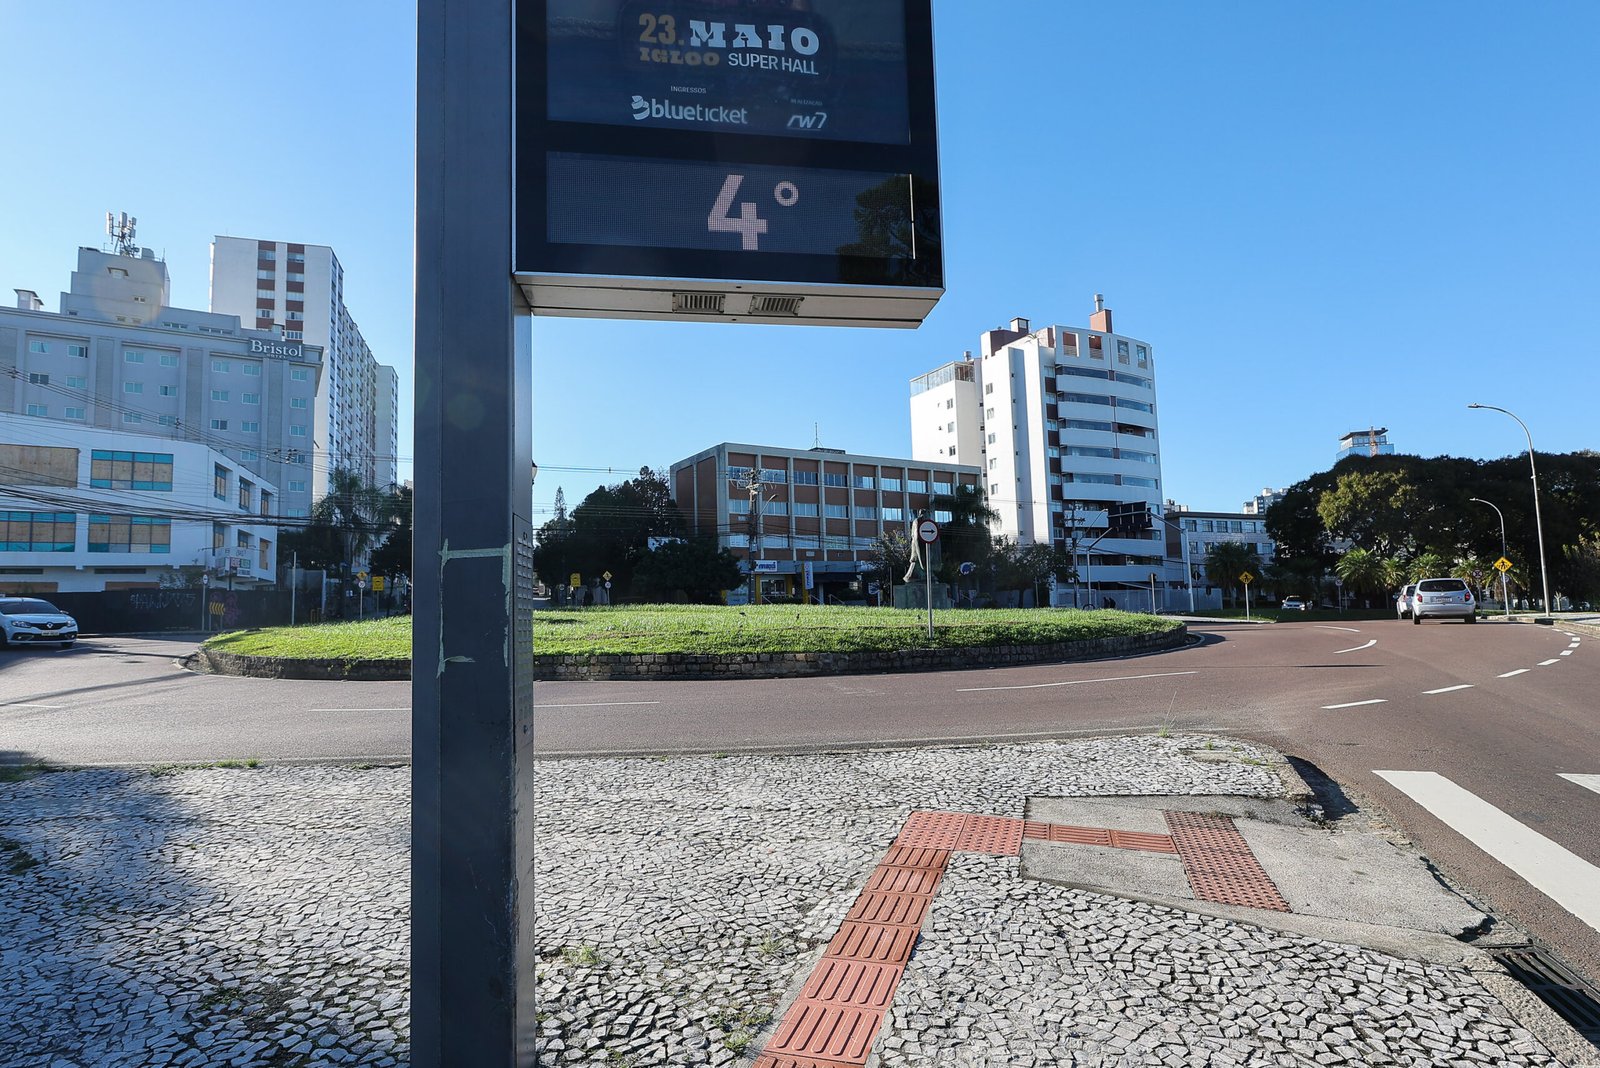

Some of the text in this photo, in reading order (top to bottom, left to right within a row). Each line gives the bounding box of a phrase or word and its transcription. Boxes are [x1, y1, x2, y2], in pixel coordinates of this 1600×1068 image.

[689, 19, 820, 56] MAIO
[639, 47, 820, 76] IGLOO SUPER HALL
[651, 97, 748, 125] blueticket
[250, 339, 302, 357] Bristol
